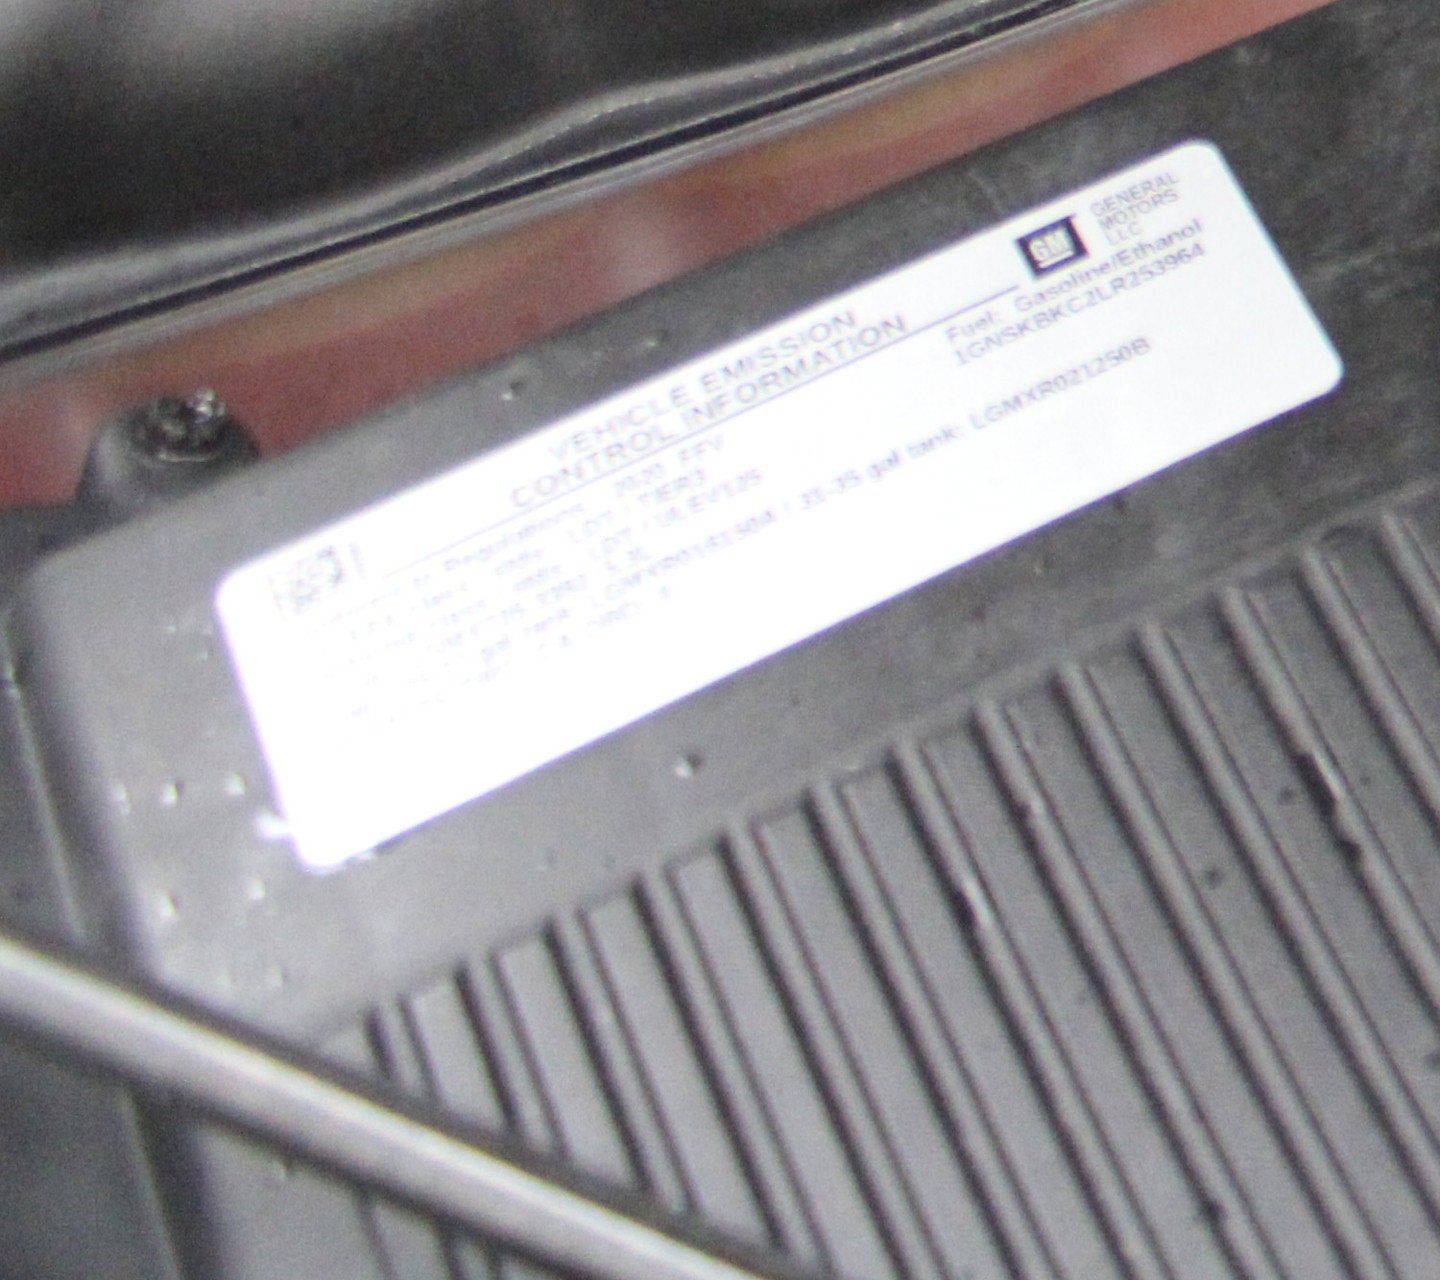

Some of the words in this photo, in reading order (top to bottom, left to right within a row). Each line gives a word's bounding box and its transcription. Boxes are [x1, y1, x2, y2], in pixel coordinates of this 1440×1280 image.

[1089, 167, 1179, 220] GENERAL
[1098, 185, 1180, 234] MOTORS
[1030, 225, 1076, 262] GM
[1105, 219, 1144, 247] LLC
[943, 308, 1001, 346] Fuel:
[1012, 214, 1204, 317] Gasoline/Ethanol
[507, 419, 673, 509] CONTROL
[708, 312, 909, 418] INFORMATION
[547, 382, 694, 464] VEHICLE
[697, 307, 858, 395] EMISSION
[861, 446, 906, 483] gal
